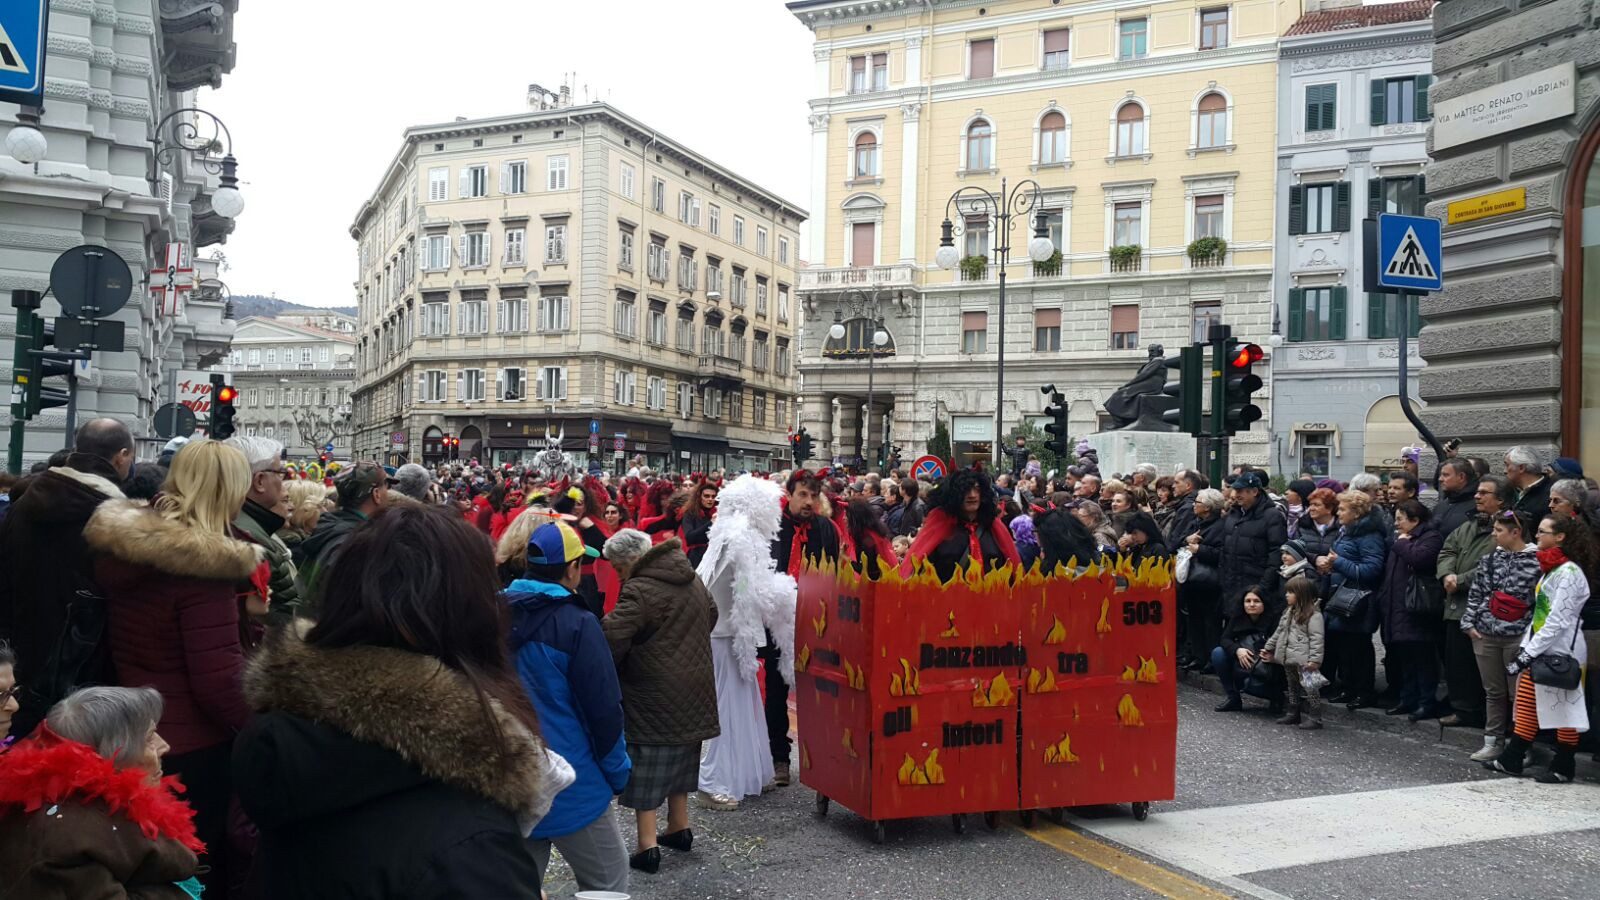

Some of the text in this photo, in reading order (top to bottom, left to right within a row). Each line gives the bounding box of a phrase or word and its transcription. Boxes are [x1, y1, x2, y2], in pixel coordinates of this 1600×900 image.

[1438, 79, 1569, 124] VIA MATTEO RENATO IMBRIANI
[1494, 201, 1517, 210] GIOVANNI
[1302, 422, 1328, 430] CAD
[1122, 600, 1163, 626] 503
[1057, 651, 1088, 675] tra
